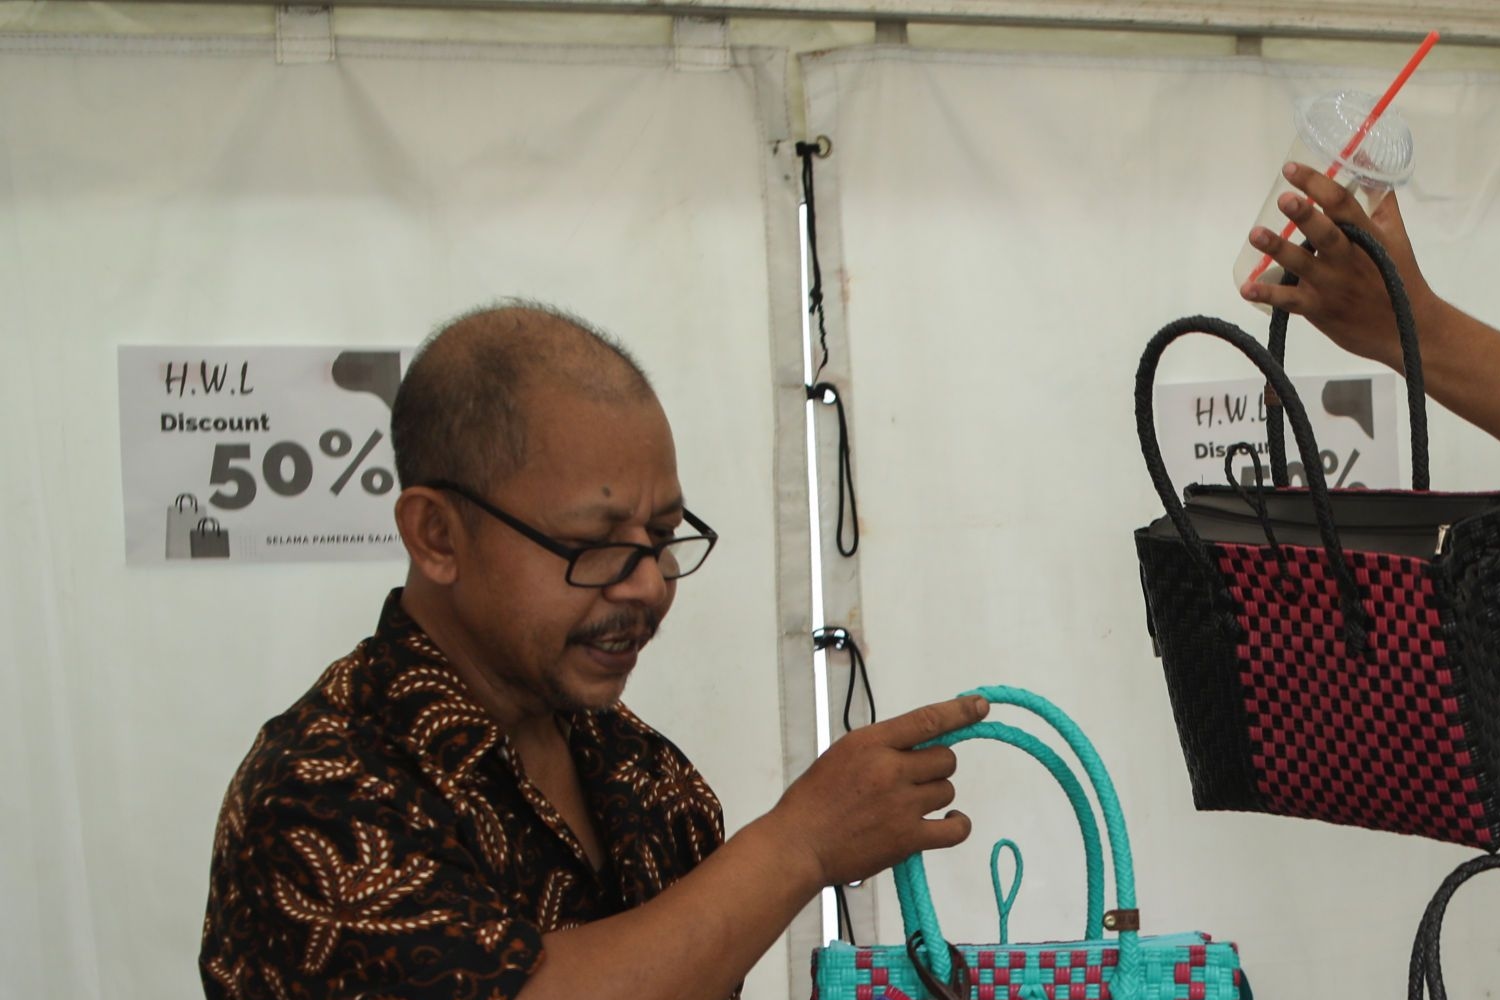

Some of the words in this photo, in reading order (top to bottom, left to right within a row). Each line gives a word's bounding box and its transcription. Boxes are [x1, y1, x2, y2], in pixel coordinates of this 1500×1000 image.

[160, 412, 270, 432] Discount
[208, 428, 395, 511] 50%
[266, 535, 309, 545] SELAMA
[312, 533, 365, 545] PAMERAN
